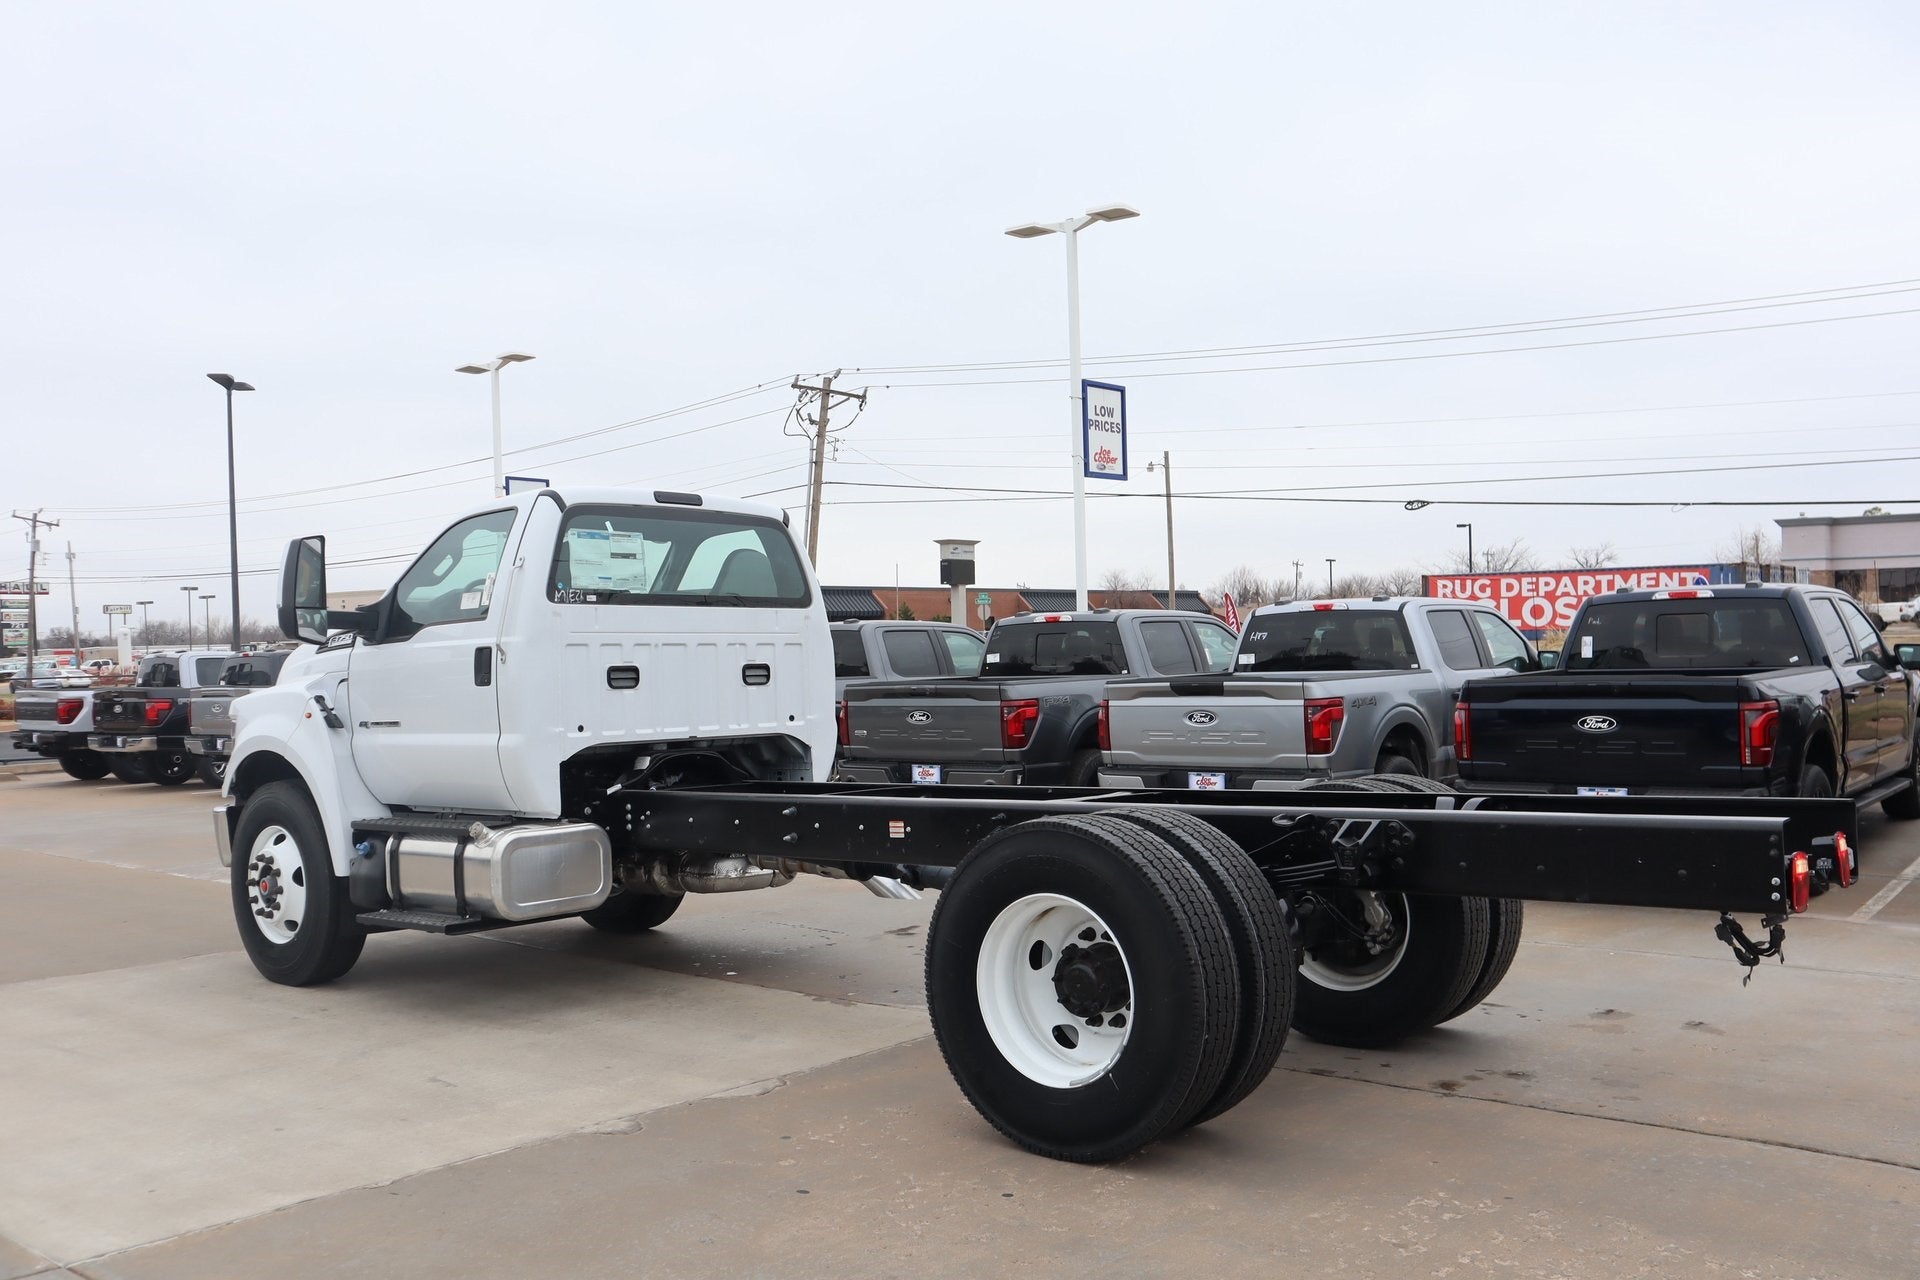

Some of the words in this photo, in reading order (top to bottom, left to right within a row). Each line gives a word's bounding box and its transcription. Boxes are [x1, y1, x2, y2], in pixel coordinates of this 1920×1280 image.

[1094, 405, 1115, 418] LOW
[1088, 418, 1121, 434] PRICES
[1099, 445, 1111, 457] Joe
[1093, 451, 1118, 465] Cooper
[1437, 579, 1492, 598] RUG
[1500, 571, 1701, 598] DEPARTMENT
[1196, 779, 1217, 787] Cooper
